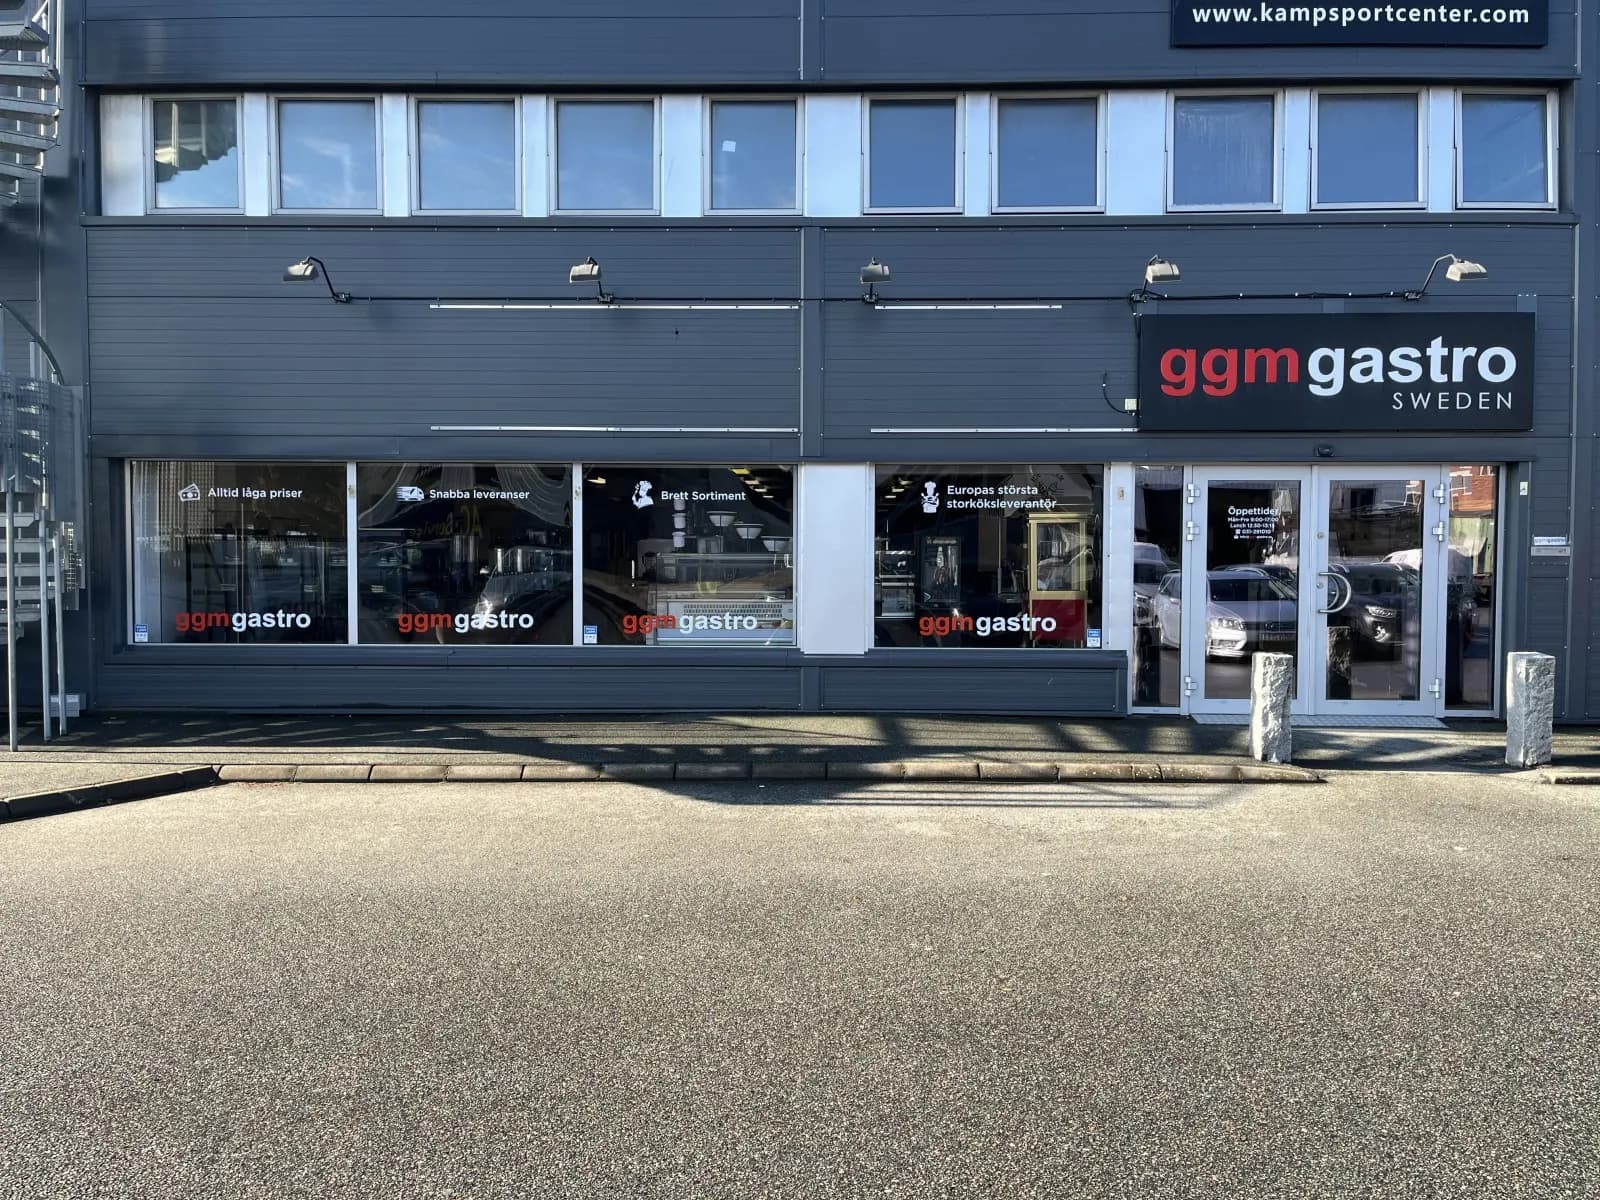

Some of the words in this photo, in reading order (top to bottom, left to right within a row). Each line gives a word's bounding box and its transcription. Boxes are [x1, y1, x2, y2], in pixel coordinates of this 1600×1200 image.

[1192, 2, 1530, 27] www.kampsportcenter.com
[1391, 391, 1512, 410] SWEDEN
[207, 487, 239, 498] Alltid
[241, 486, 267, 501] låga
[269, 487, 303, 501] priser
[429, 488, 470, 500] Snabba
[472, 489, 531, 500] leveranser
[661, 490, 689, 502] Brett
[691, 490, 747, 502] Sortiment
[947, 485, 995, 497] Europas
[996, 484, 1039, 496] största
[946, 498, 1057, 509] storköksleverantör
[1228, 506, 1279, 516] Öppettider
